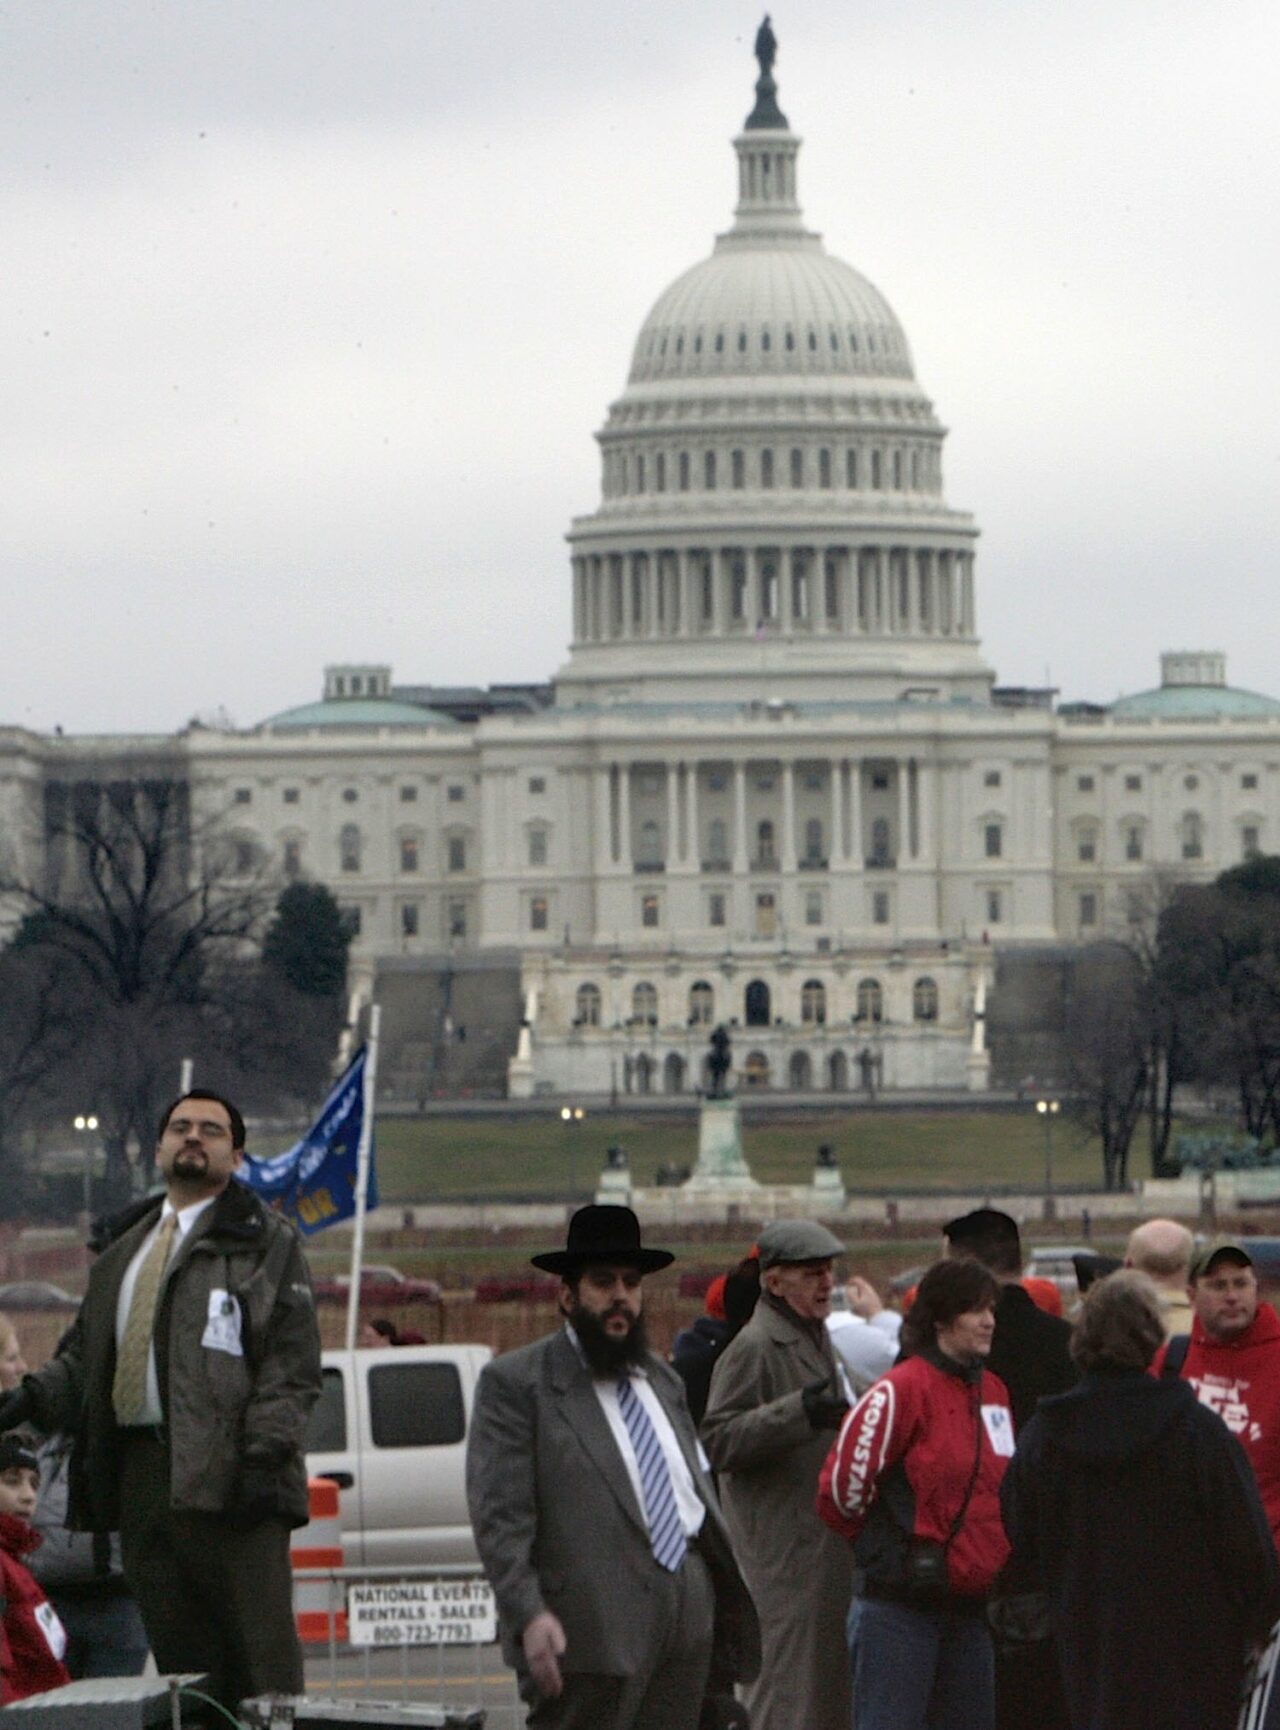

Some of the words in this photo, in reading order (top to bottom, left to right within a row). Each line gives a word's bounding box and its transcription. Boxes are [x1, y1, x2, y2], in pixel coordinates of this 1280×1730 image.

[846, 1390, 887, 1510] RONSTAN
[354, 1587, 428, 1602] NATIONAL
[432, 1584, 490, 1600] EVENTS
[358, 1606, 426, 1621] RENTALS
[440, 1604, 487, 1619] SALES
